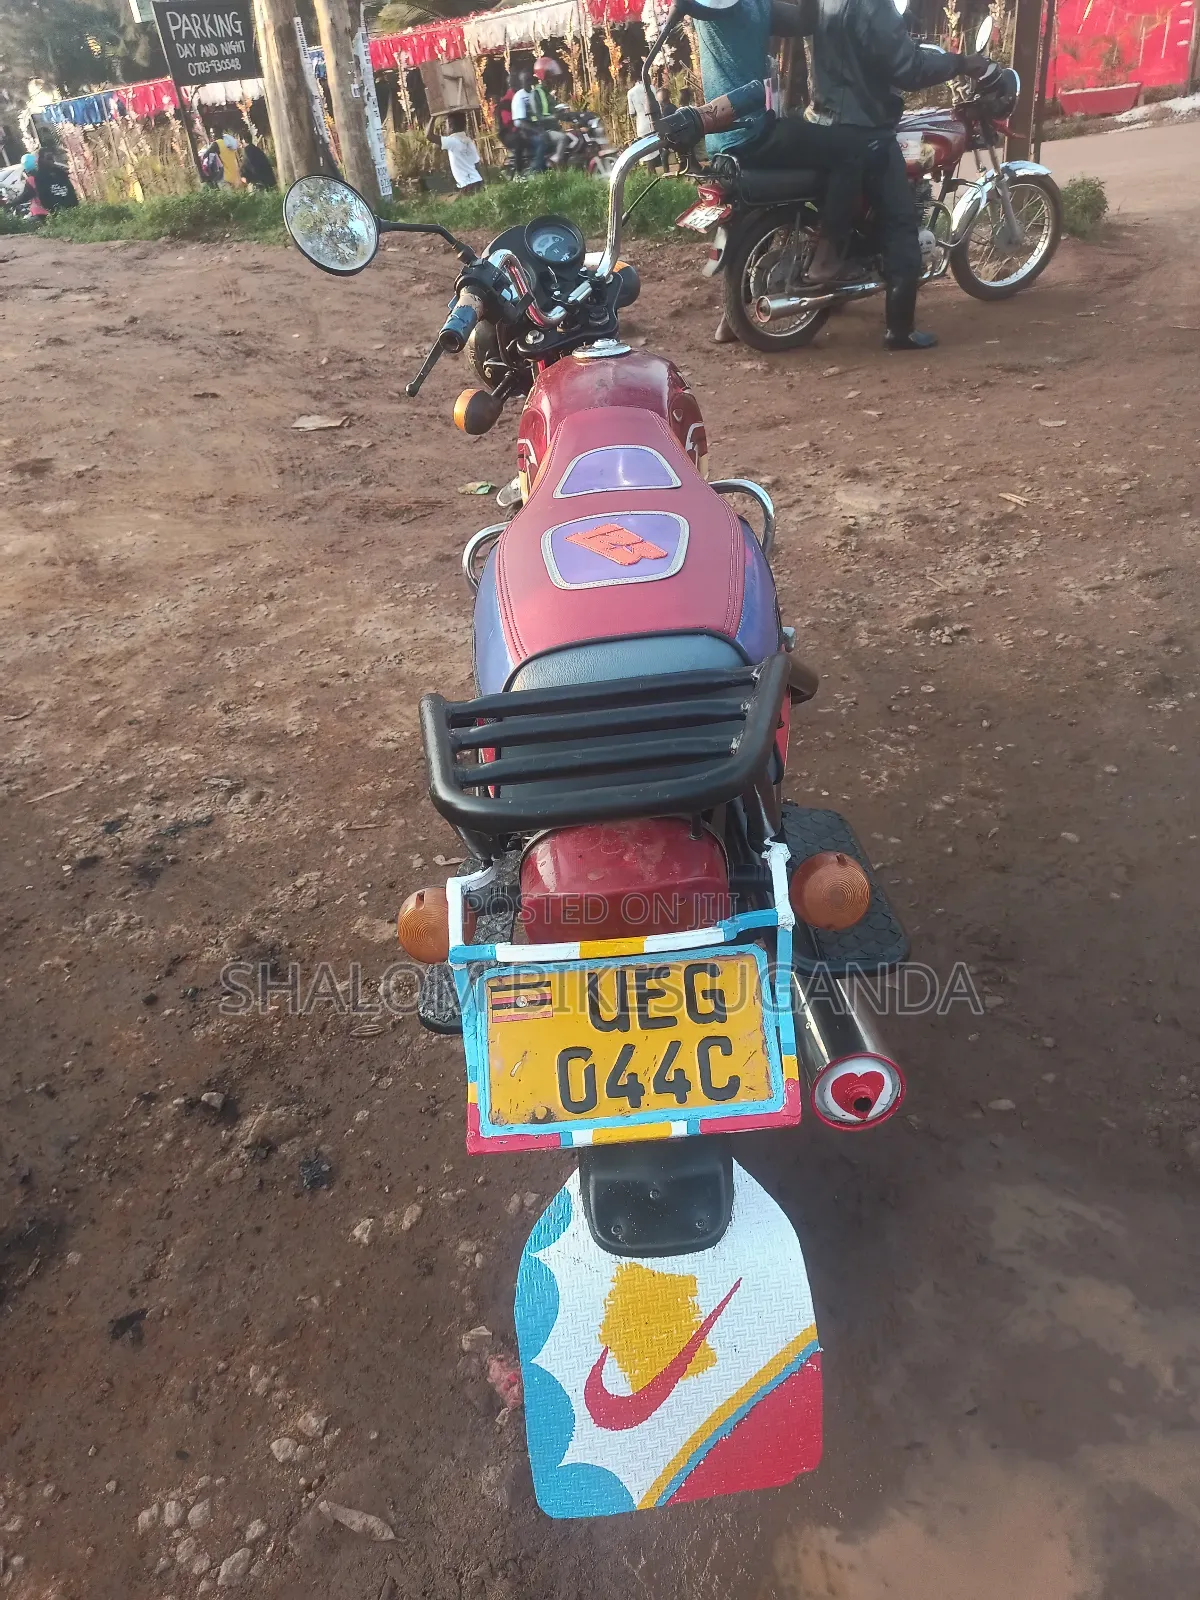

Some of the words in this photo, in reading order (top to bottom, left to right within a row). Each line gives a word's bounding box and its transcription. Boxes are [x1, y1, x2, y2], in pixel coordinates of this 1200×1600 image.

[165, 11, 243, 40] PARKING
[175, 42, 197, 59] DAY
[200, 42, 219, 58] AND
[220, 40, 246, 56] NIGHT
[587, 962, 728, 1034] UEG
[556, 1035, 741, 1115] 044C
